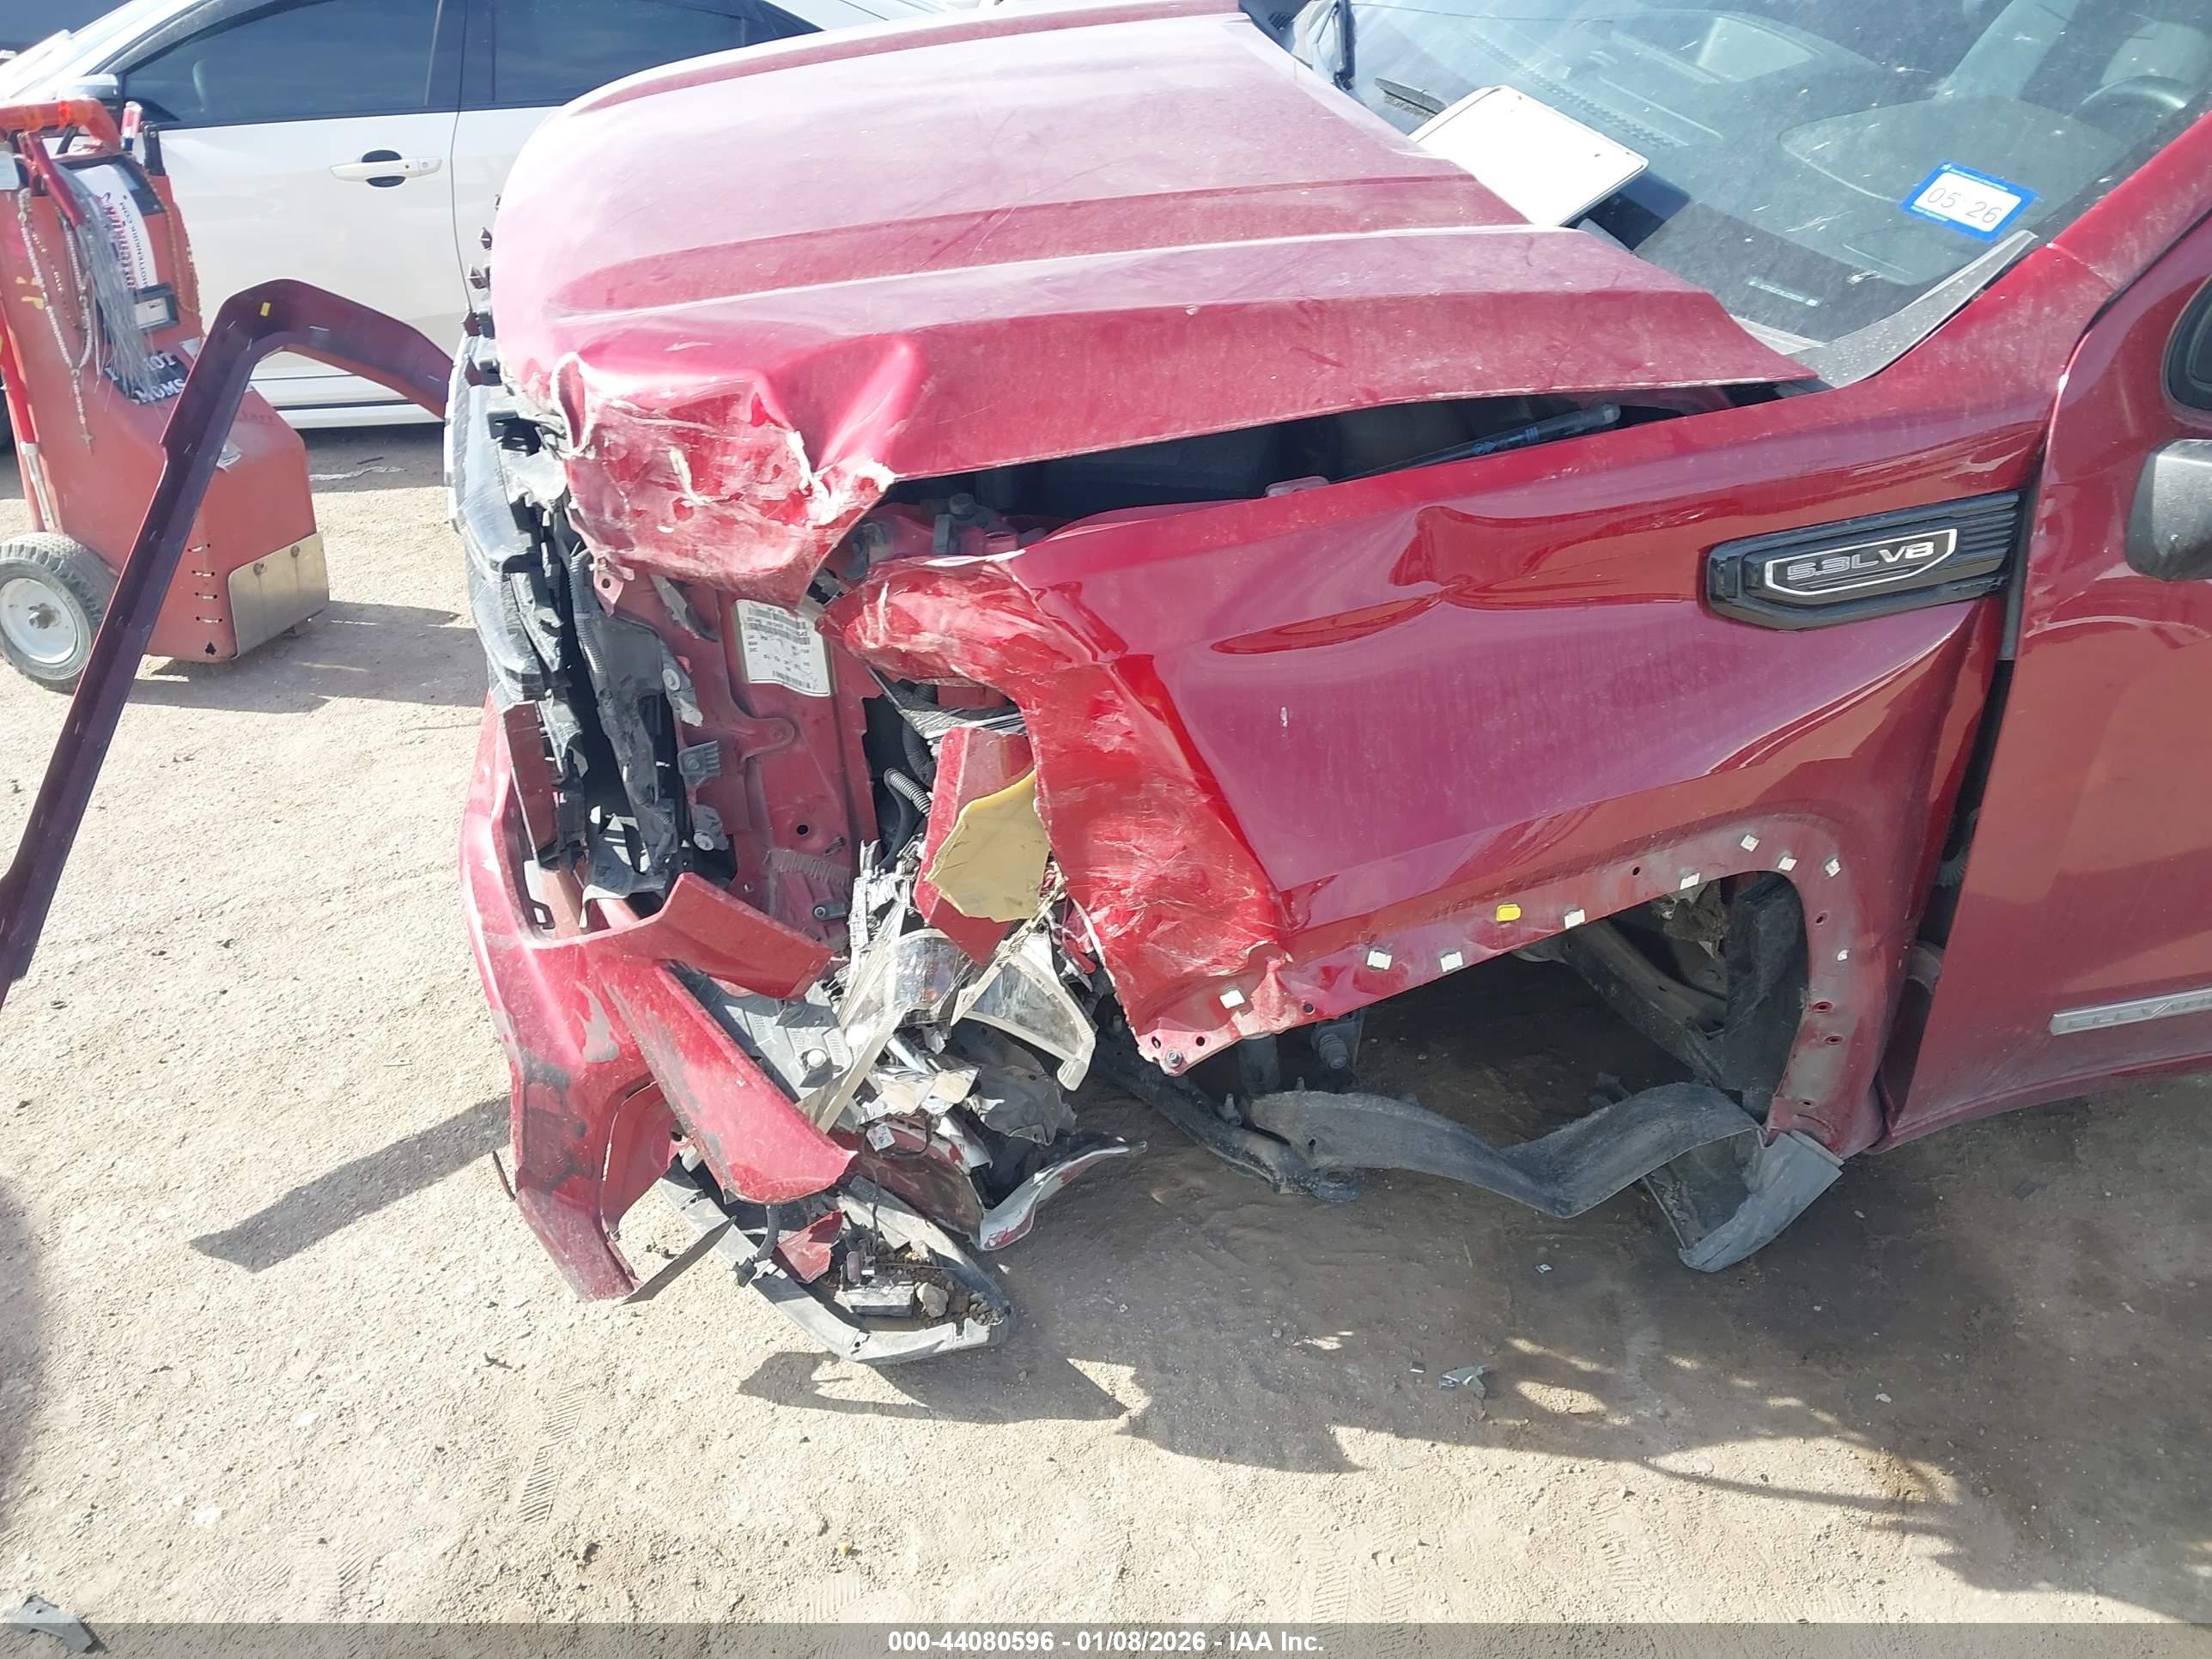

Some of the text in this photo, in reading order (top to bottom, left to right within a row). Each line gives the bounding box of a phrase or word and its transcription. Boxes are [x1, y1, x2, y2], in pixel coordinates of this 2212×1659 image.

[1927, 187, 1961, 208] 05
[1965, 201, 2002, 223] 26
[134, 378, 185, 403] MOMS
